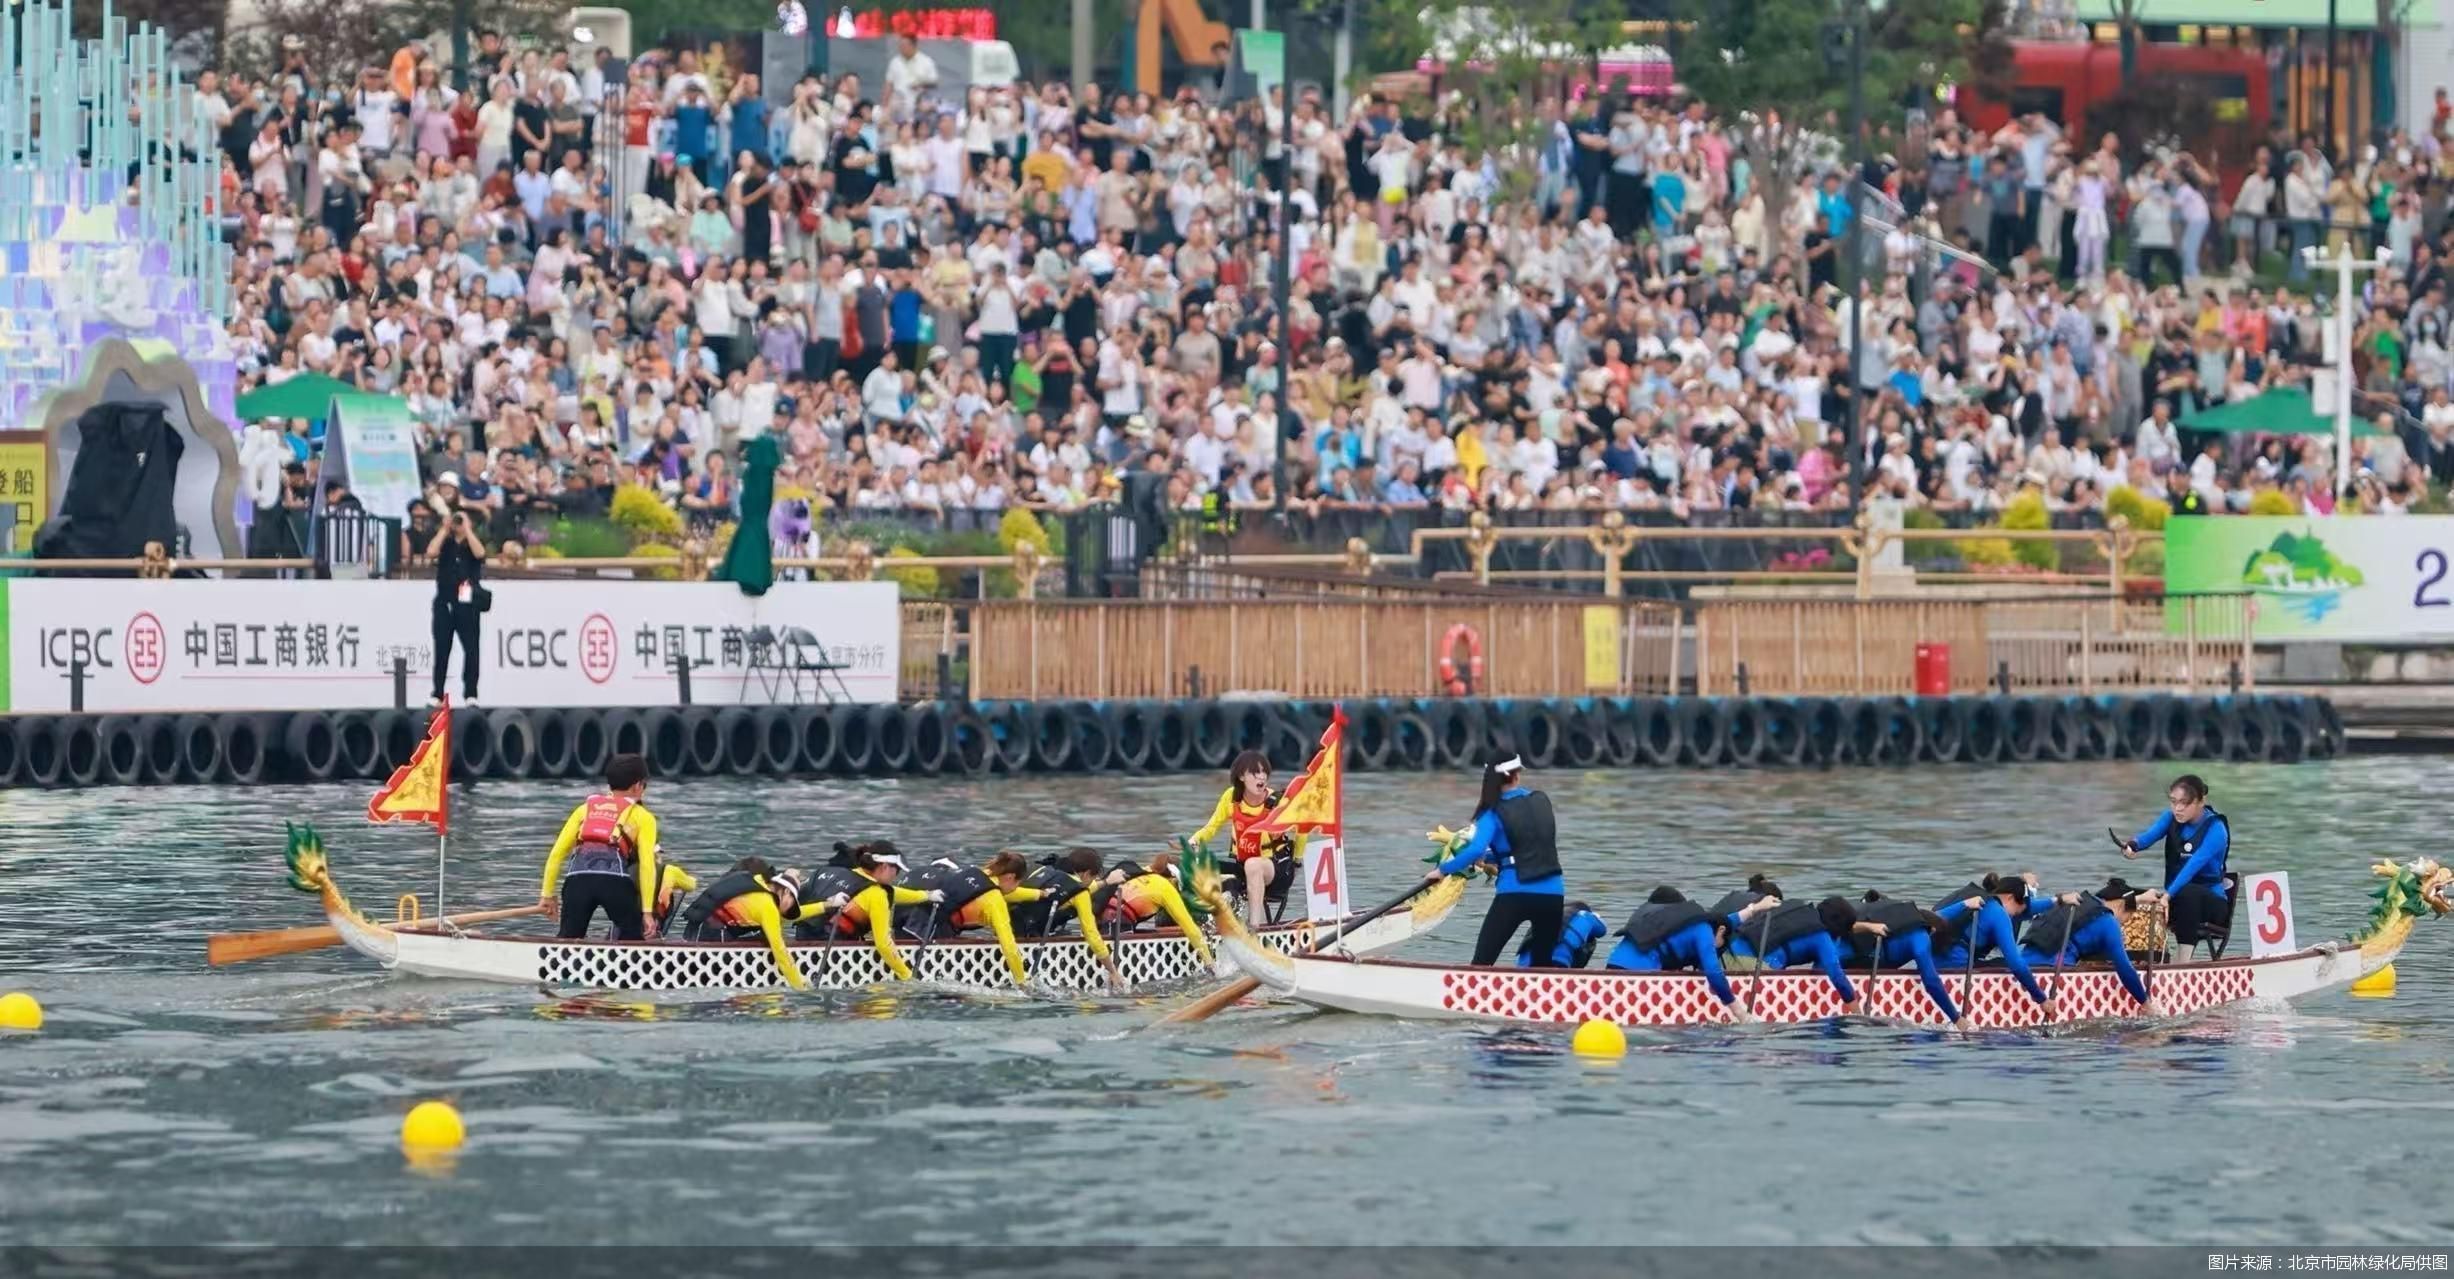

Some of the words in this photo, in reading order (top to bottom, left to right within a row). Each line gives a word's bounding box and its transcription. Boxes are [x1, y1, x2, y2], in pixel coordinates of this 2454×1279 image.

[2414, 548, 2451, 607] 2
[40, 628, 113, 668] ICBC
[184, 621, 360, 667] 中国工商银行
[497, 628, 568, 668] ICBC
[818, 643, 886, 668] 京市分行
[1312, 846, 1338, 905] 4
[2255, 879, 2287, 945] 3
